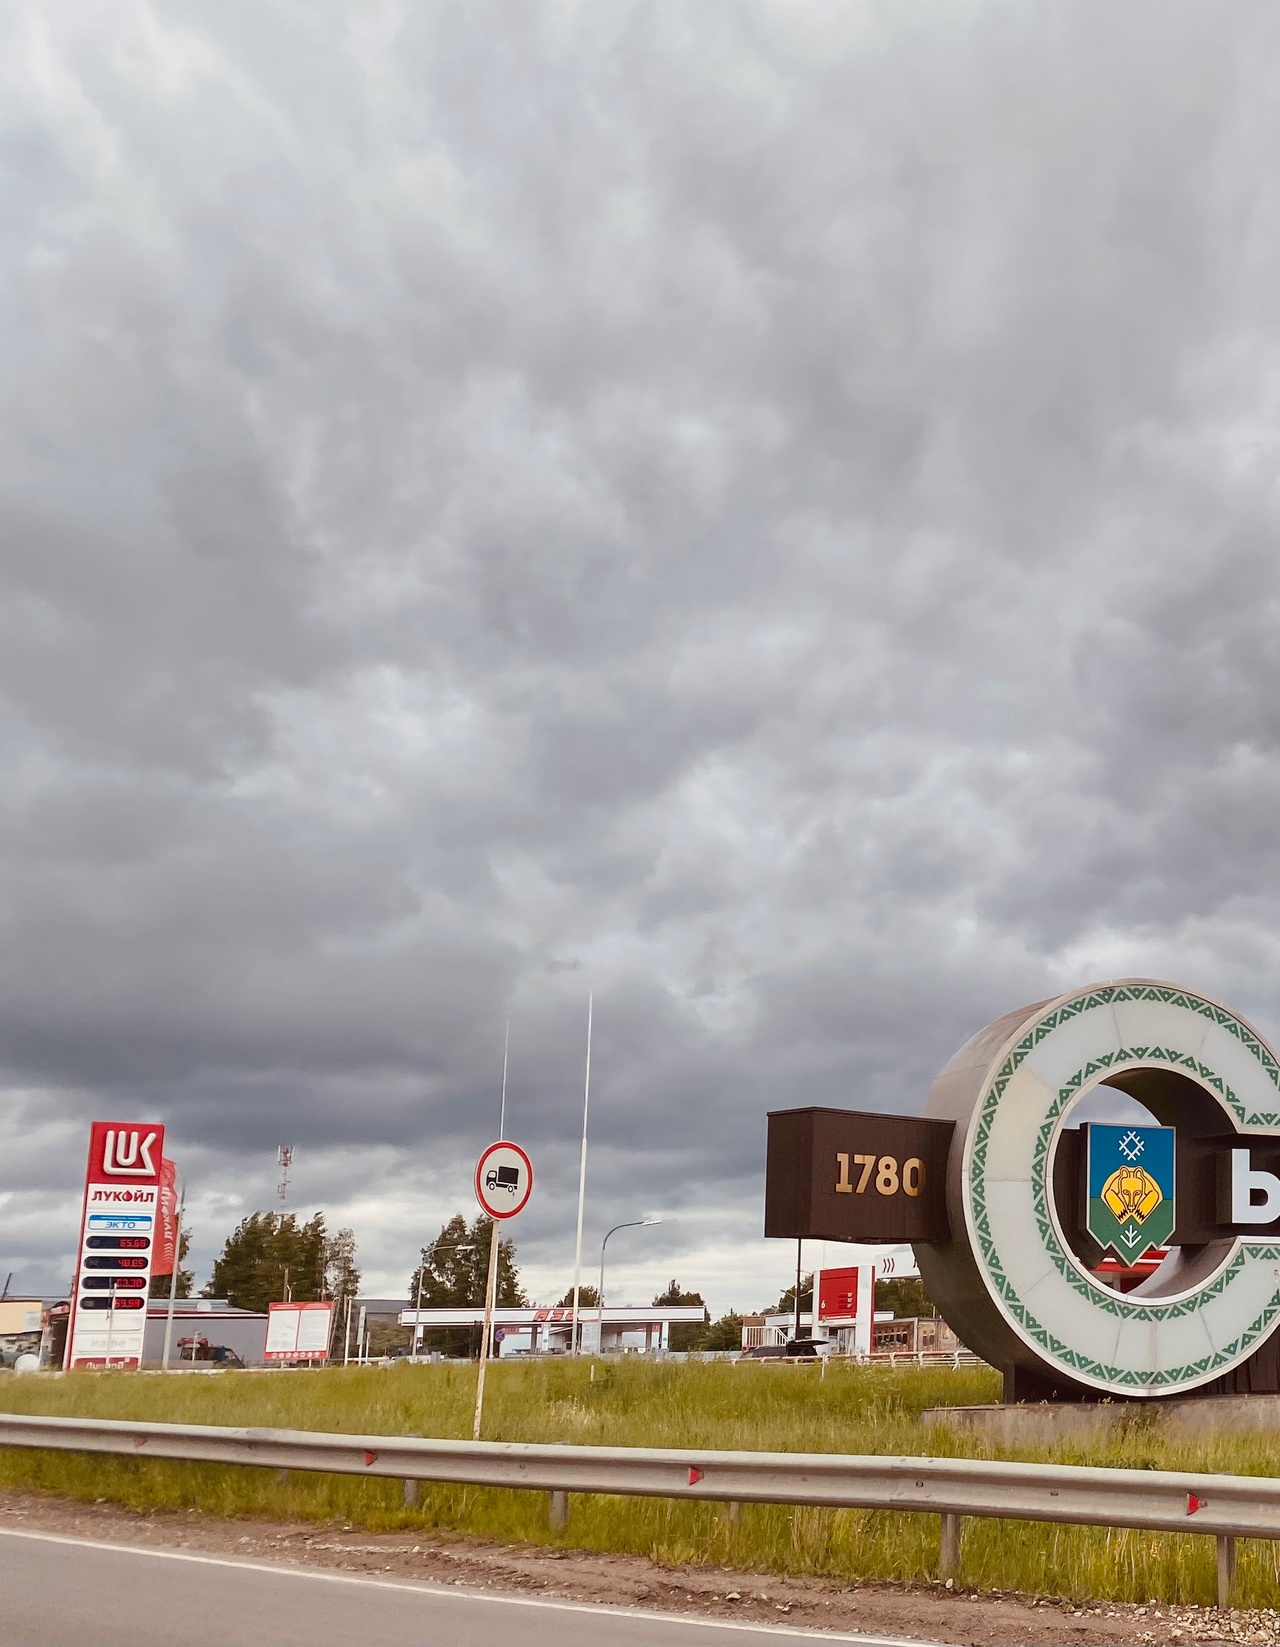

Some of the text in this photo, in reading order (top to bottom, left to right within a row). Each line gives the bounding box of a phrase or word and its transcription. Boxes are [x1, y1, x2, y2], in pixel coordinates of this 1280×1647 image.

[836, 1152, 926, 1197] 1780
[91, 1190, 154, 1202] ЛУКОЙЛ
[105, 1221, 136, 1229] ЭКТО
